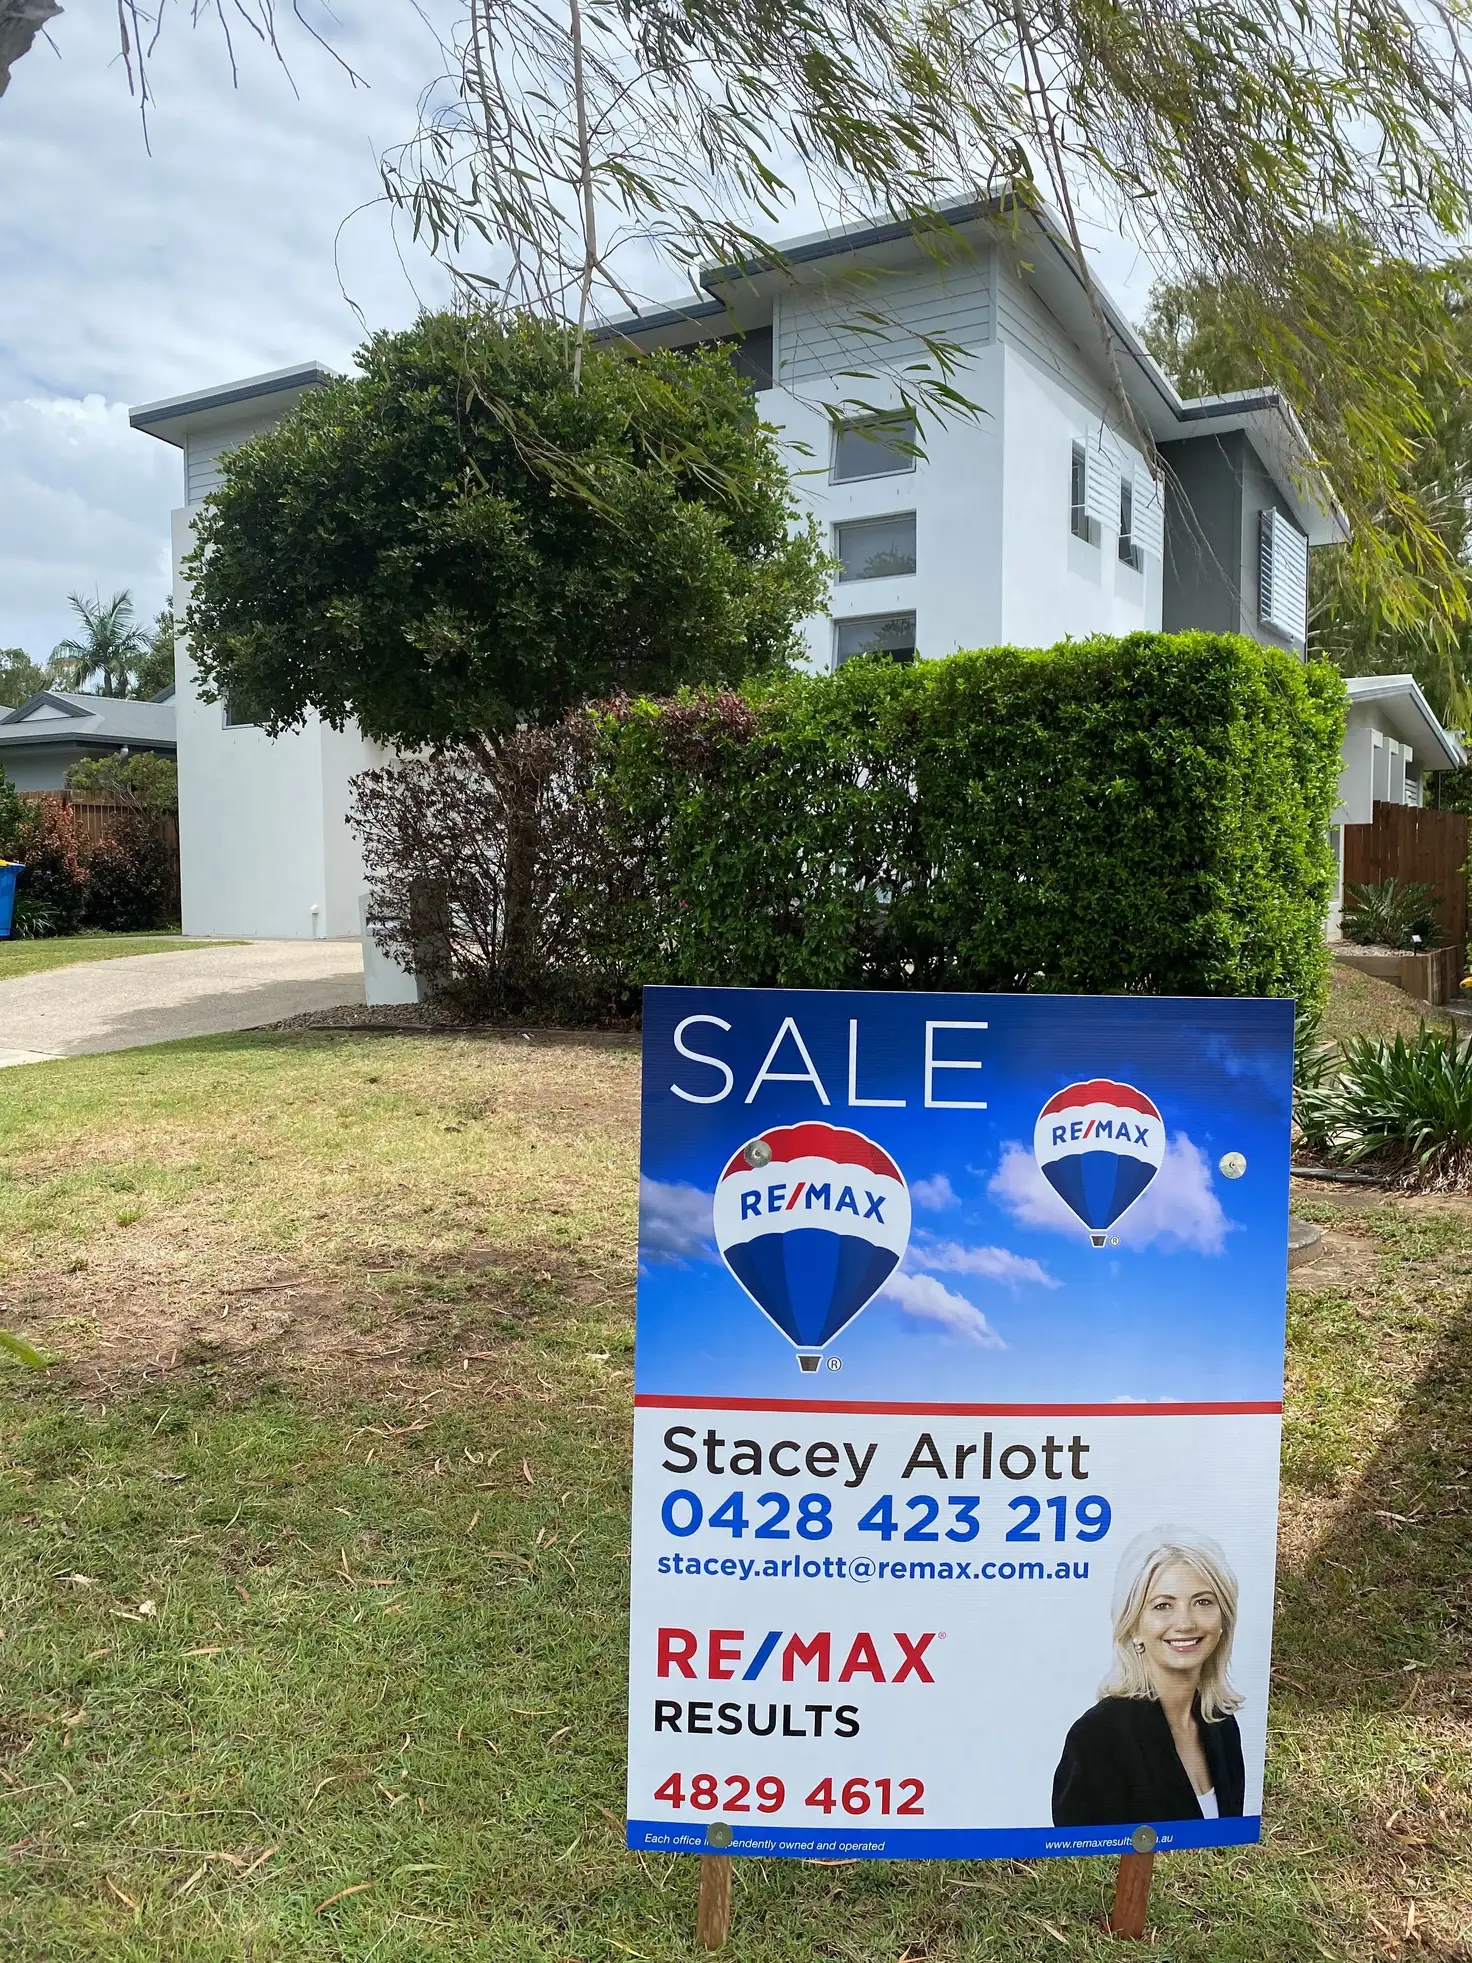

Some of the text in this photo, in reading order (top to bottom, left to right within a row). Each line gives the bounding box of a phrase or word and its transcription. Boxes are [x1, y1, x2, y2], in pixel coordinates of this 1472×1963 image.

[670, 1014, 989, 1110] SALE
[1051, 1119, 1149, 1148] RE/MAX
[740, 1181, 886, 1226] RE/MAX
[661, 1425, 1091, 1488] Stacey Arlott
[660, 1488, 1112, 1543] 0428 423 219
[656, 1551, 1090, 1584] stacey.arlott@remax.com.au
[654, 1700, 860, 1738] RESULTS
[653, 1772, 925, 1815] 4829 4612
[644, 1832, 670, 1845] Each
[673, 1835, 701, 1847] office
[778, 1840, 814, 1851] owned
[816, 1839, 836, 1852] and
[838, 1840, 885, 1853] operated
